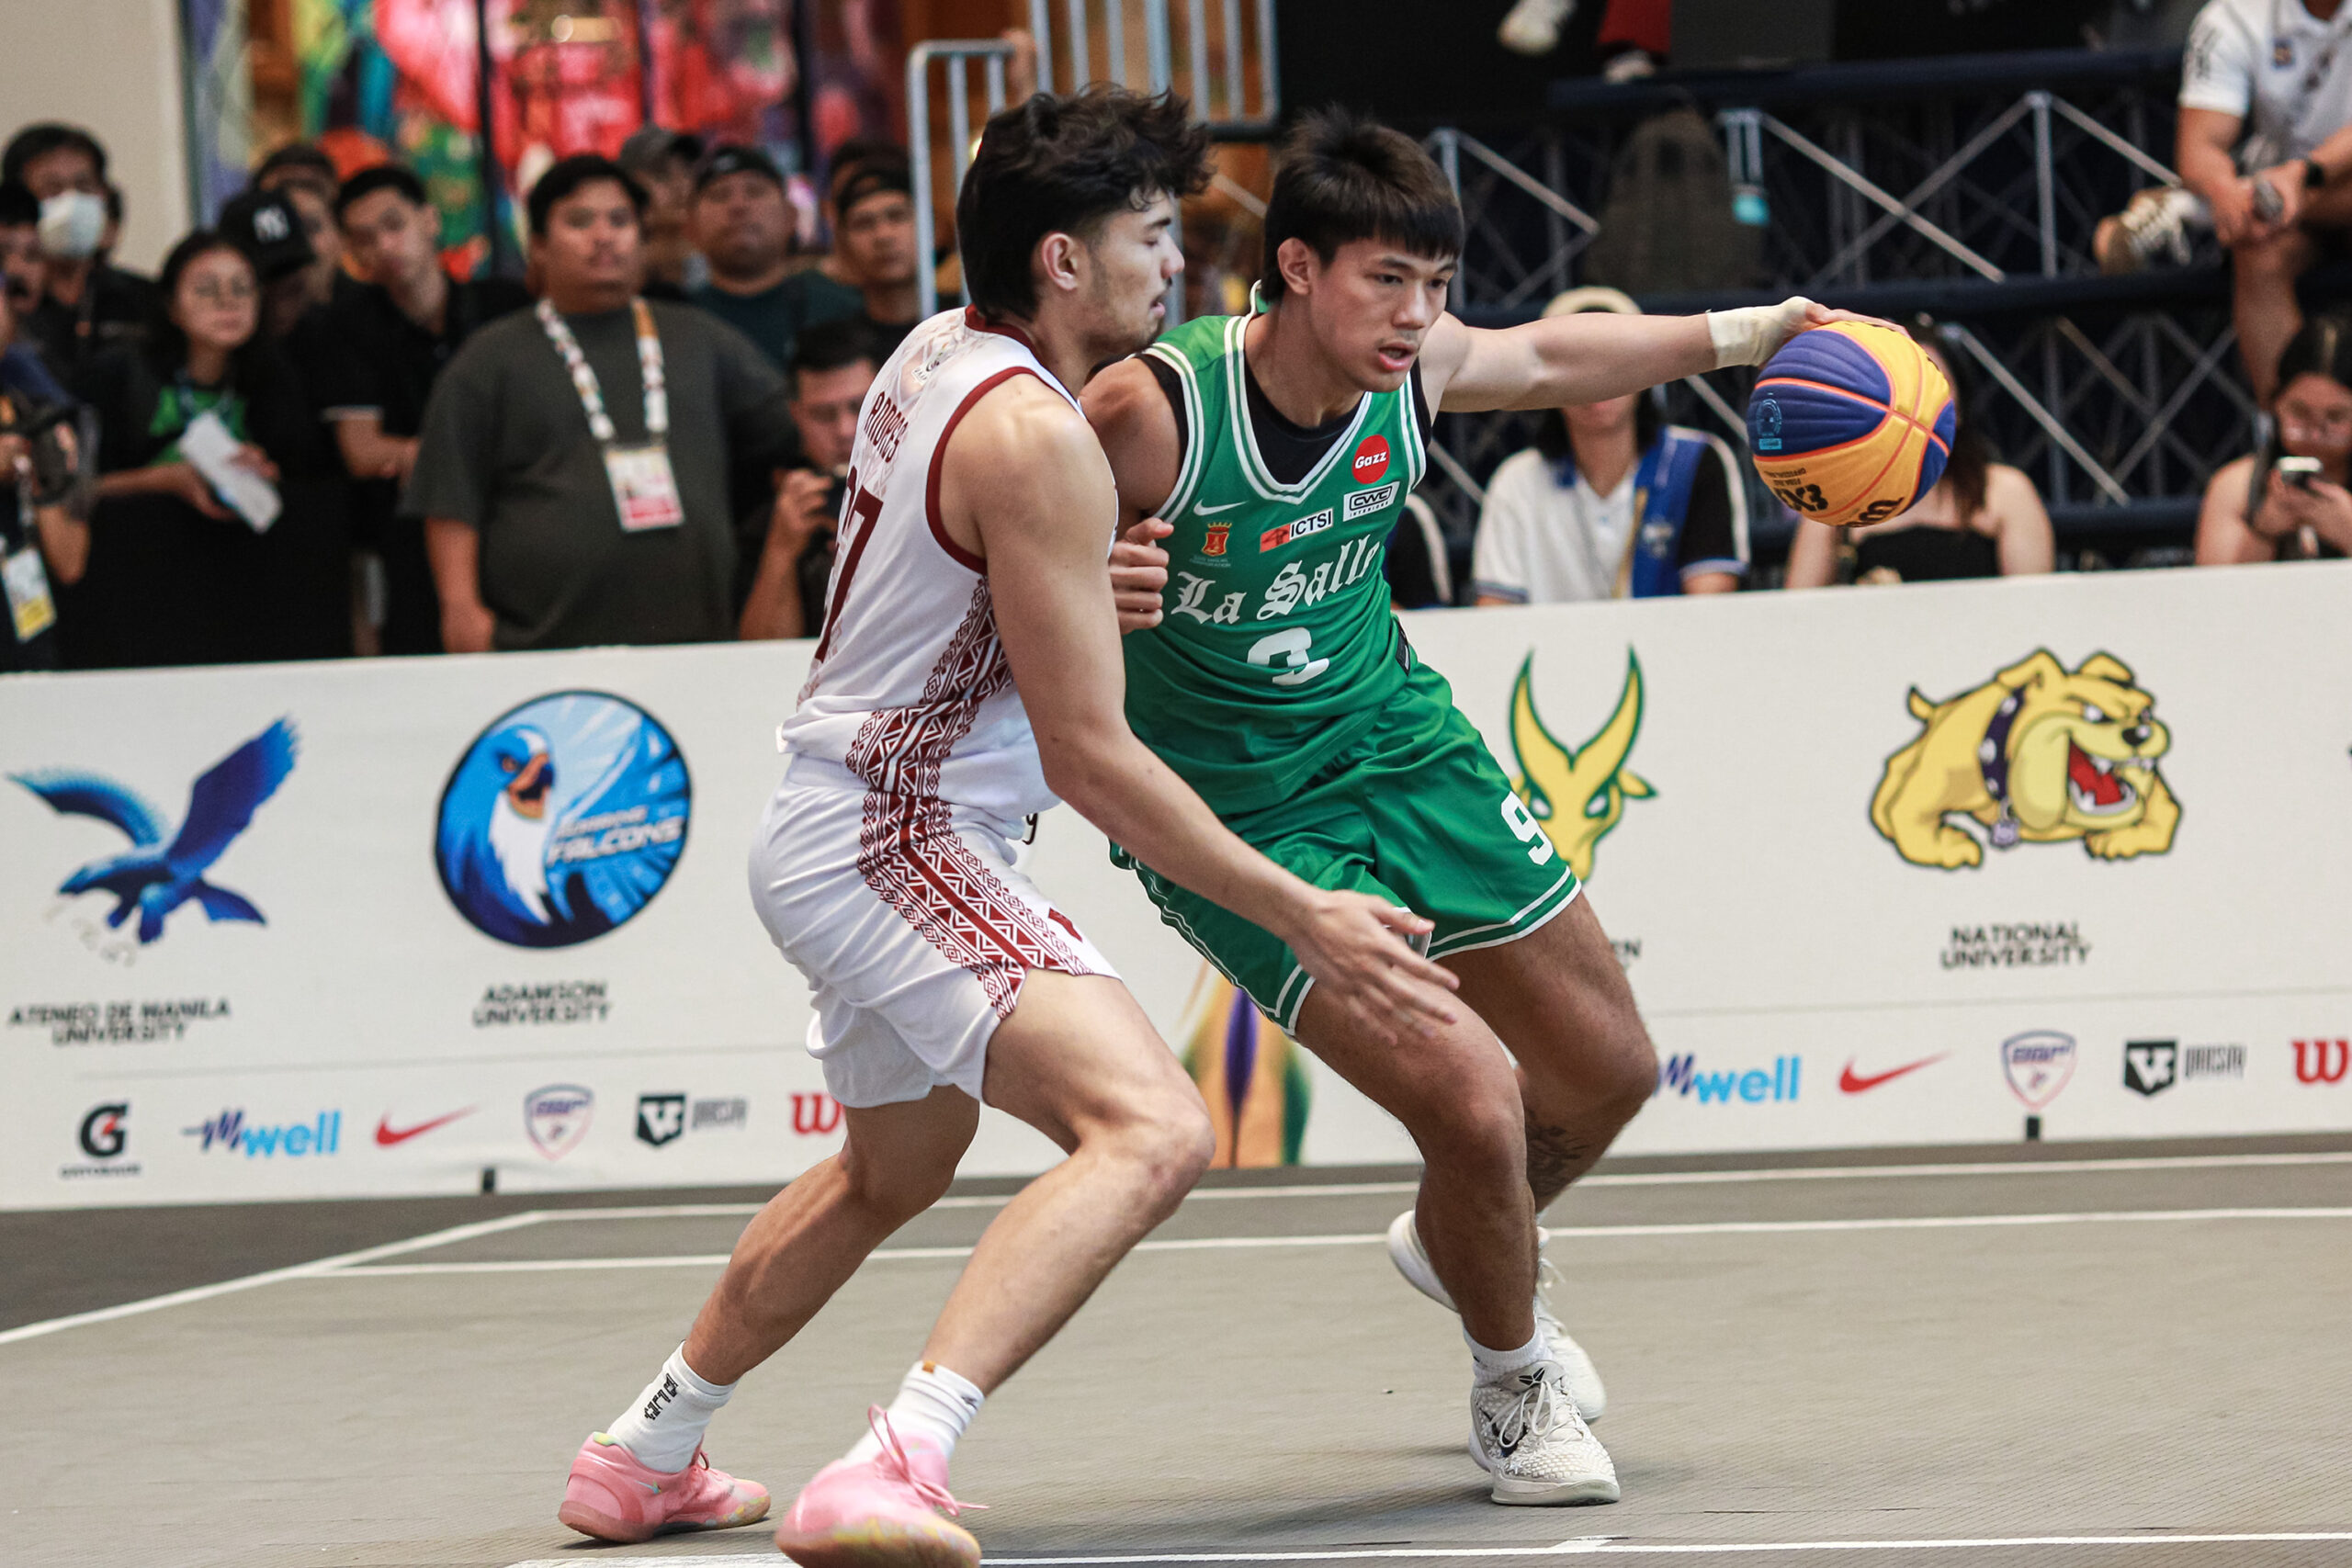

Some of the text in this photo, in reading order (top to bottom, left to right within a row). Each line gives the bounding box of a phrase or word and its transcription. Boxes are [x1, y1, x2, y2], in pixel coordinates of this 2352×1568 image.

[1354, 451, 1387, 469] Gazz
[1291, 511, 1331, 537] ICTSI
[1170, 534, 1381, 625] La Salle
[1500, 790, 1555, 866] 9
[1951, 920, 2079, 944] NATIONAL
[1940, 942, 2092, 970] UNIVERSITY
[472, 1001, 614, 1027] UNIVERSITY
